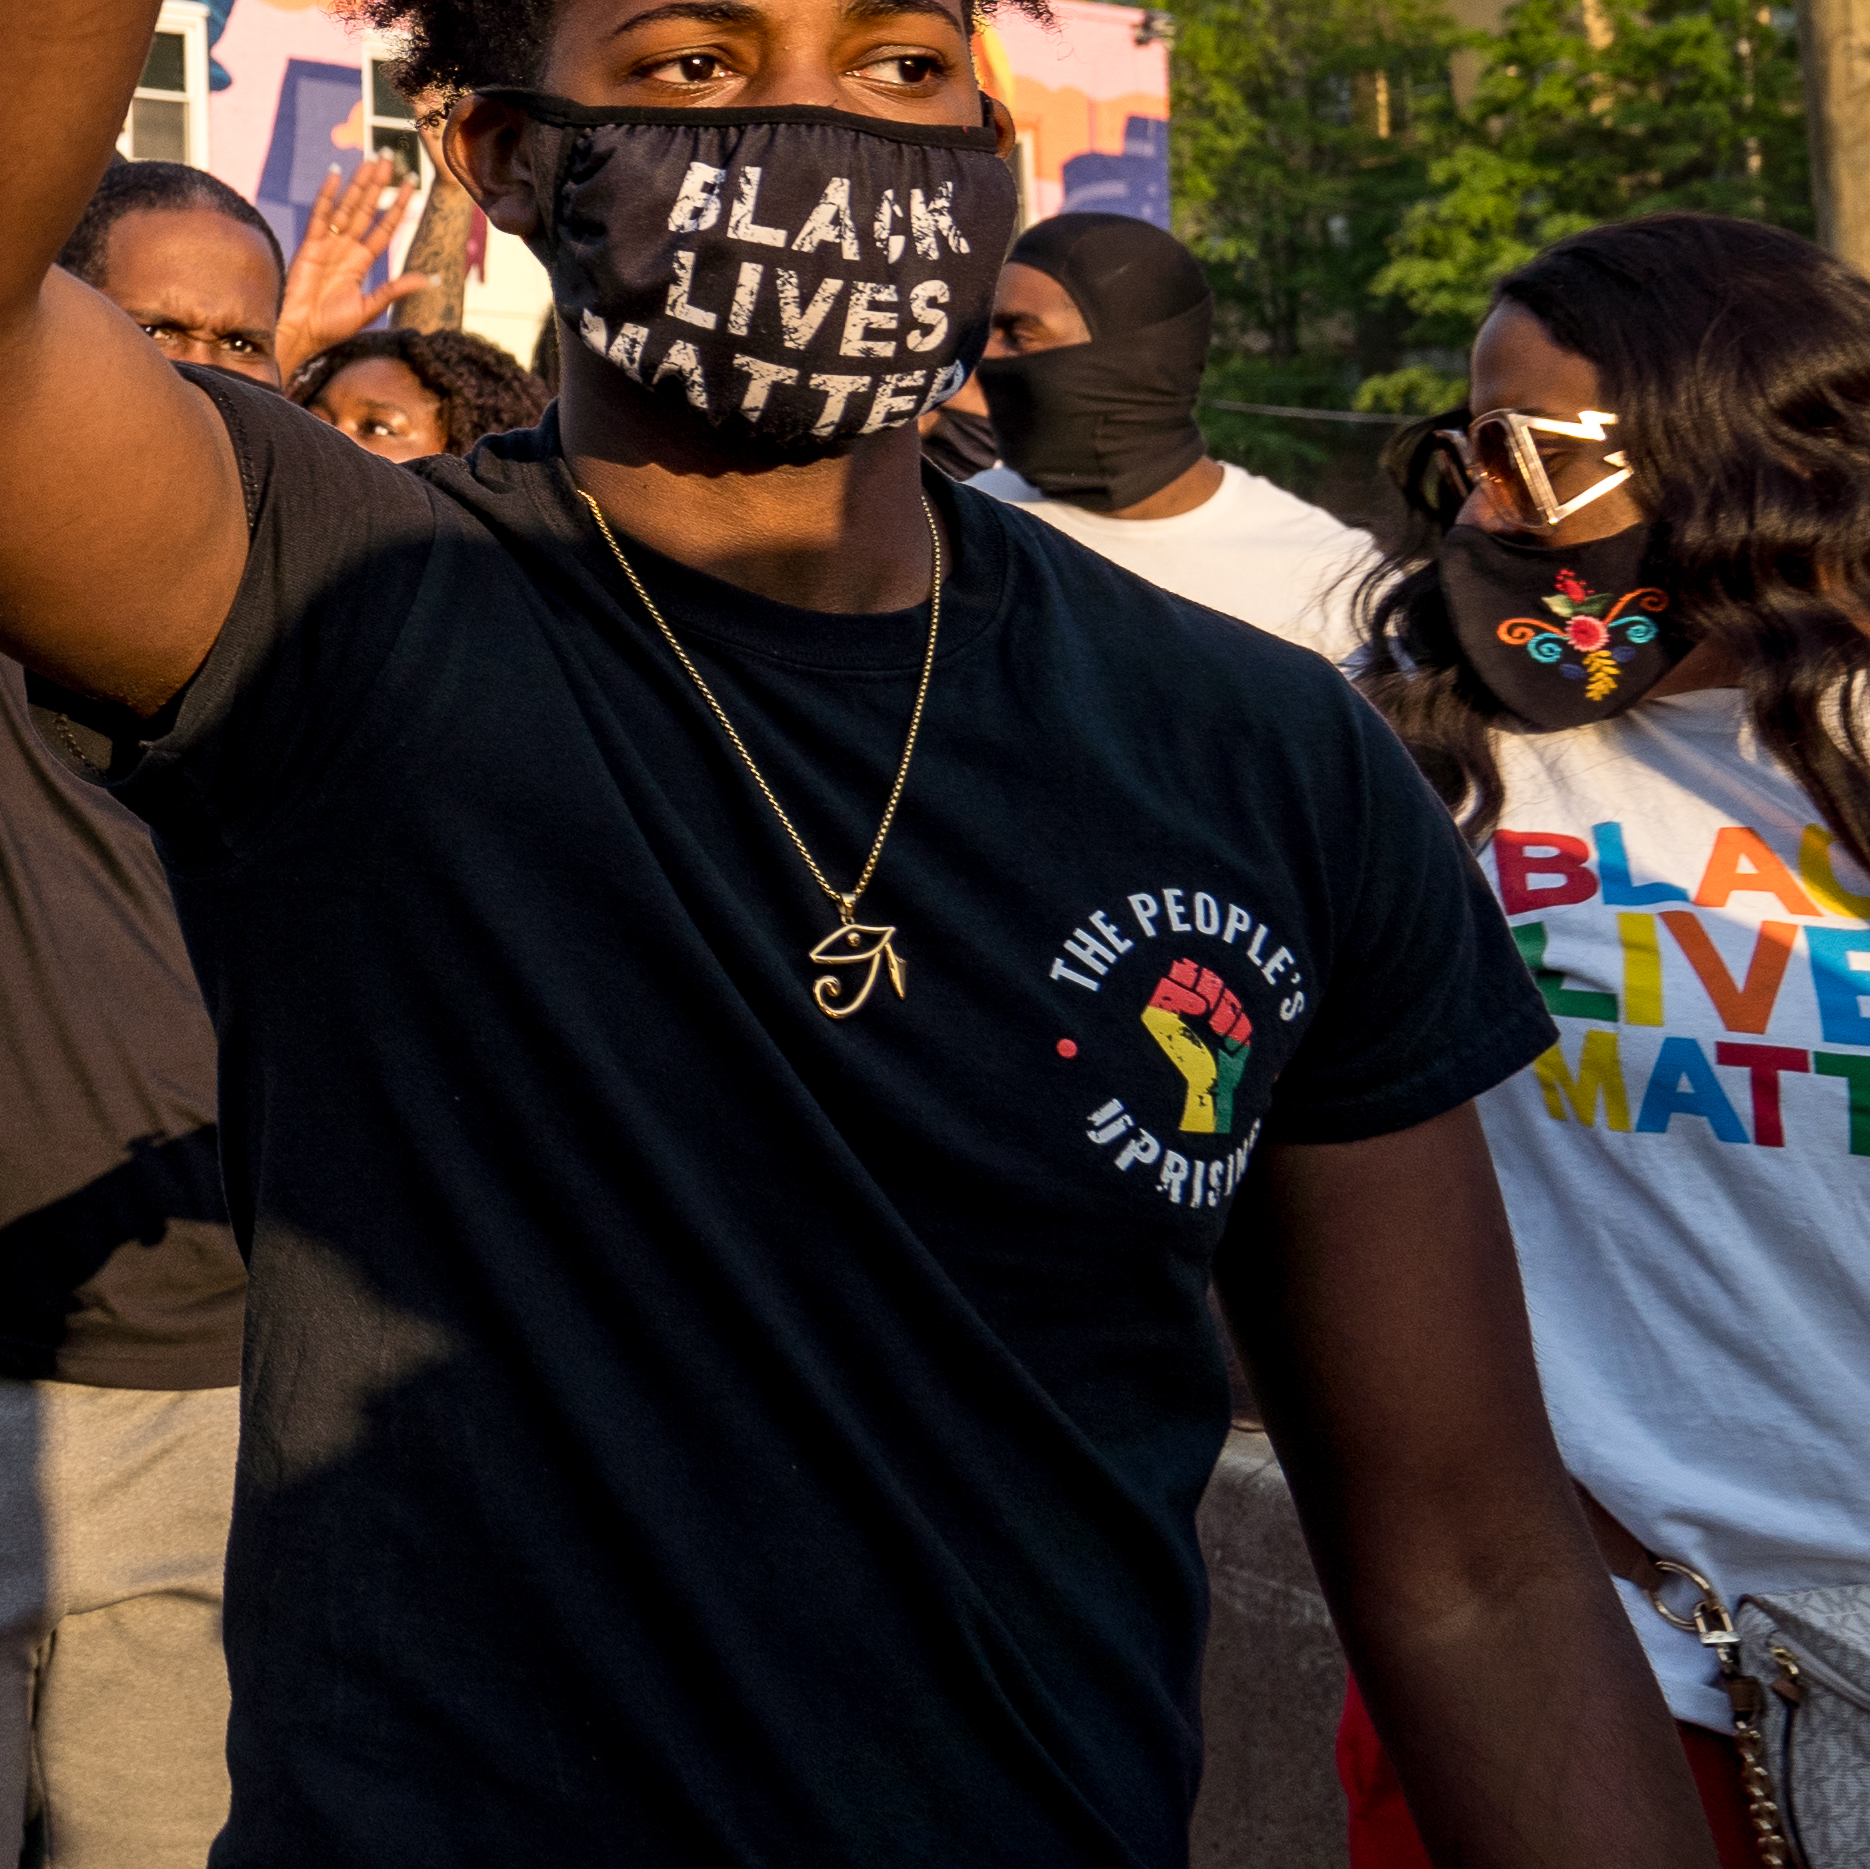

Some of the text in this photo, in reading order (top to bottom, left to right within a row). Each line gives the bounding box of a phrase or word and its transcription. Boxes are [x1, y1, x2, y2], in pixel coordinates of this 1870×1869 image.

[667, 160, 971, 265] BLACK
[664, 250, 951, 359] LIVES
[1049, 887, 1305, 1022] THE PEOPLE'S
